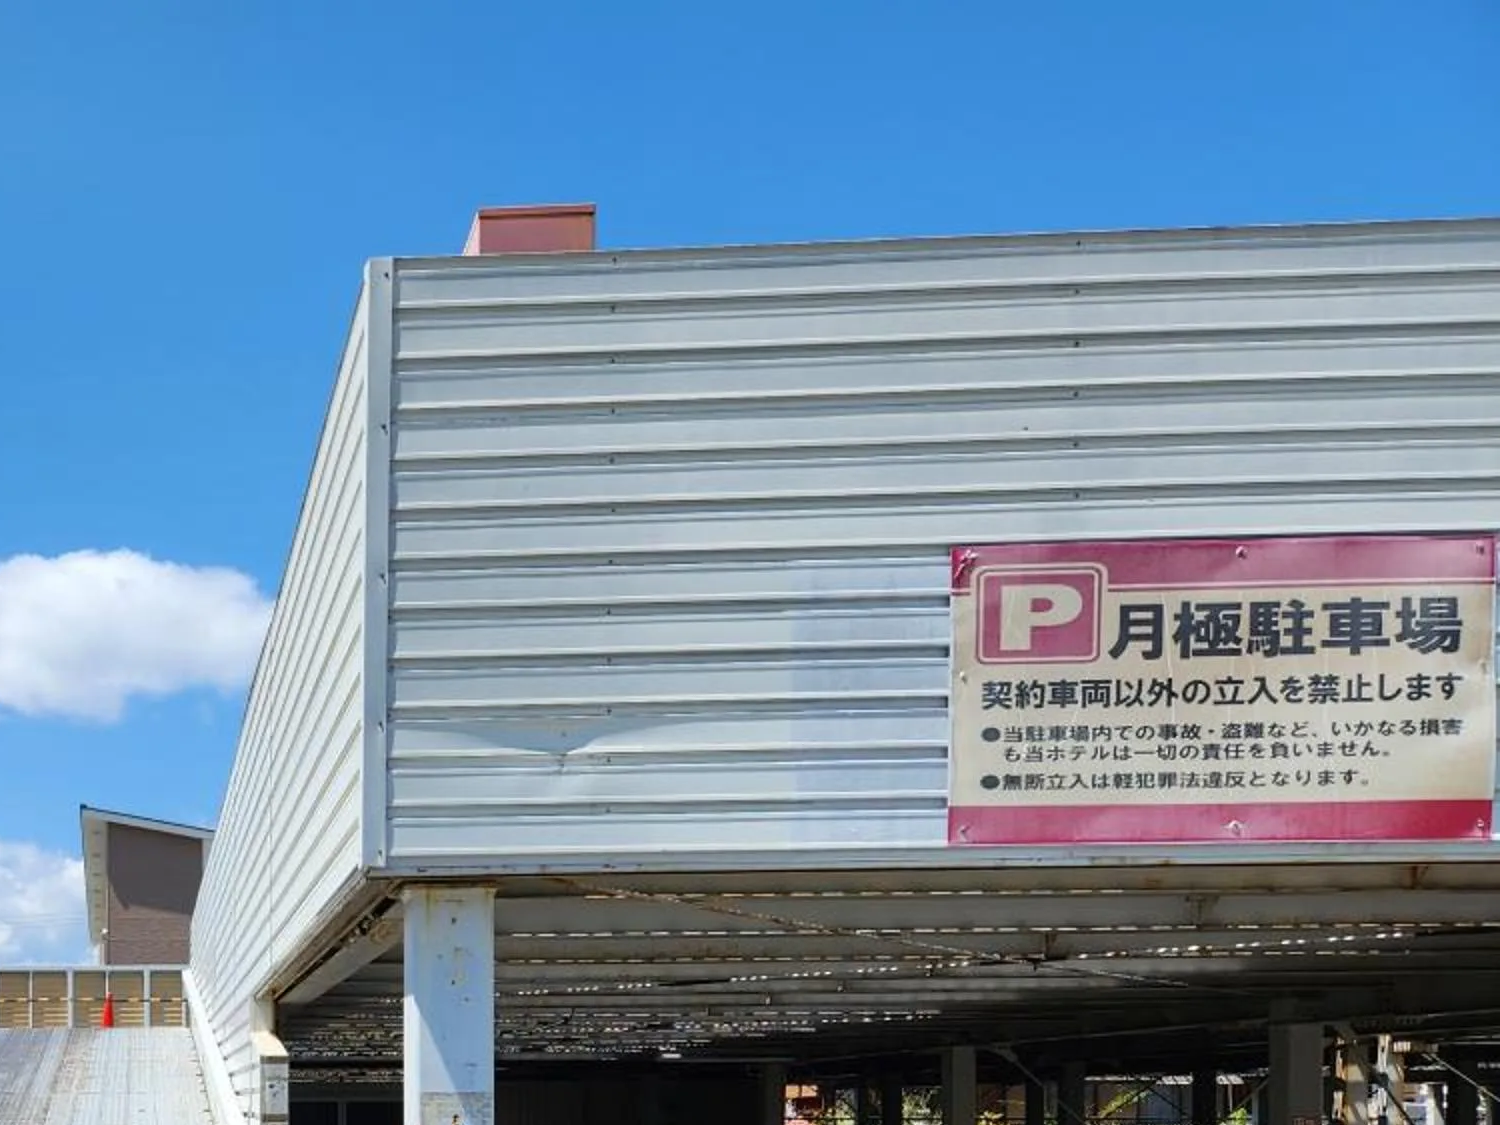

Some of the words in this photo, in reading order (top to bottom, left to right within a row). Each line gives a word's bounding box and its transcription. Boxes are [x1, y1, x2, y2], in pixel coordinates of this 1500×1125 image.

[999, 583, 1083, 651] P
[1108, 596, 1464, 660] 月極駐車場
[981, 672, 1464, 710] 契約車両以外の立入を禁止します
